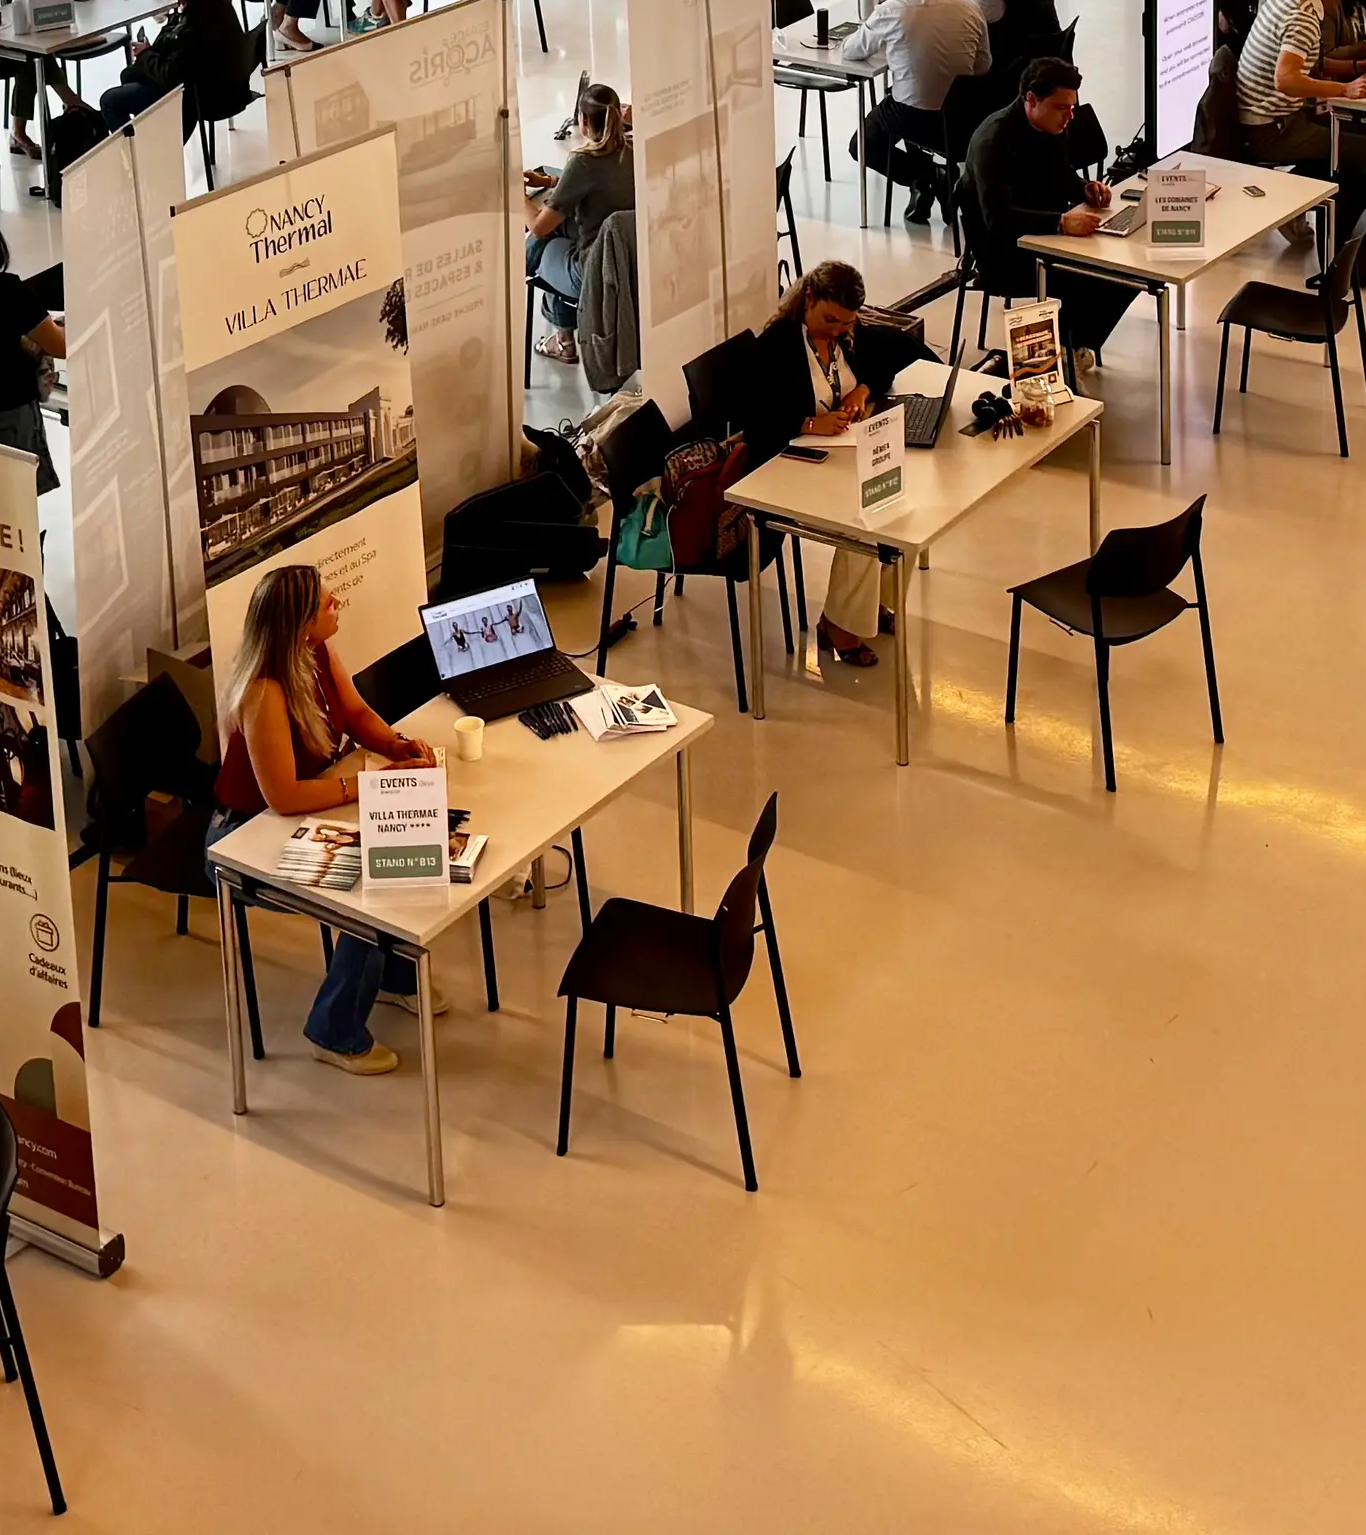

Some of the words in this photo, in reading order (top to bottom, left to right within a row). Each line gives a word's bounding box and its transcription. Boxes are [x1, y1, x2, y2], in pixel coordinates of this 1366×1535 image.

[270, 194, 325, 233] NANCY
[249, 210, 333, 263] Thermal
[225, 298, 277, 335] VILLA
[281, 258, 367, 310] THERMAE
[349, 559, 362, 571] au
[361, 548, 377, 566] Spa
[352, 572, 365, 587] de
[380, 777, 417, 788] EVENTS
[369, 810, 394, 821] VILLA
[396, 809, 439, 820] THERMAE
[377, 823, 408, 833] NANCY
[375, 858, 405, 868] STAND
[28, 952, 67, 975] Cadeaux
[29, 965, 68, 989] d'affaires
